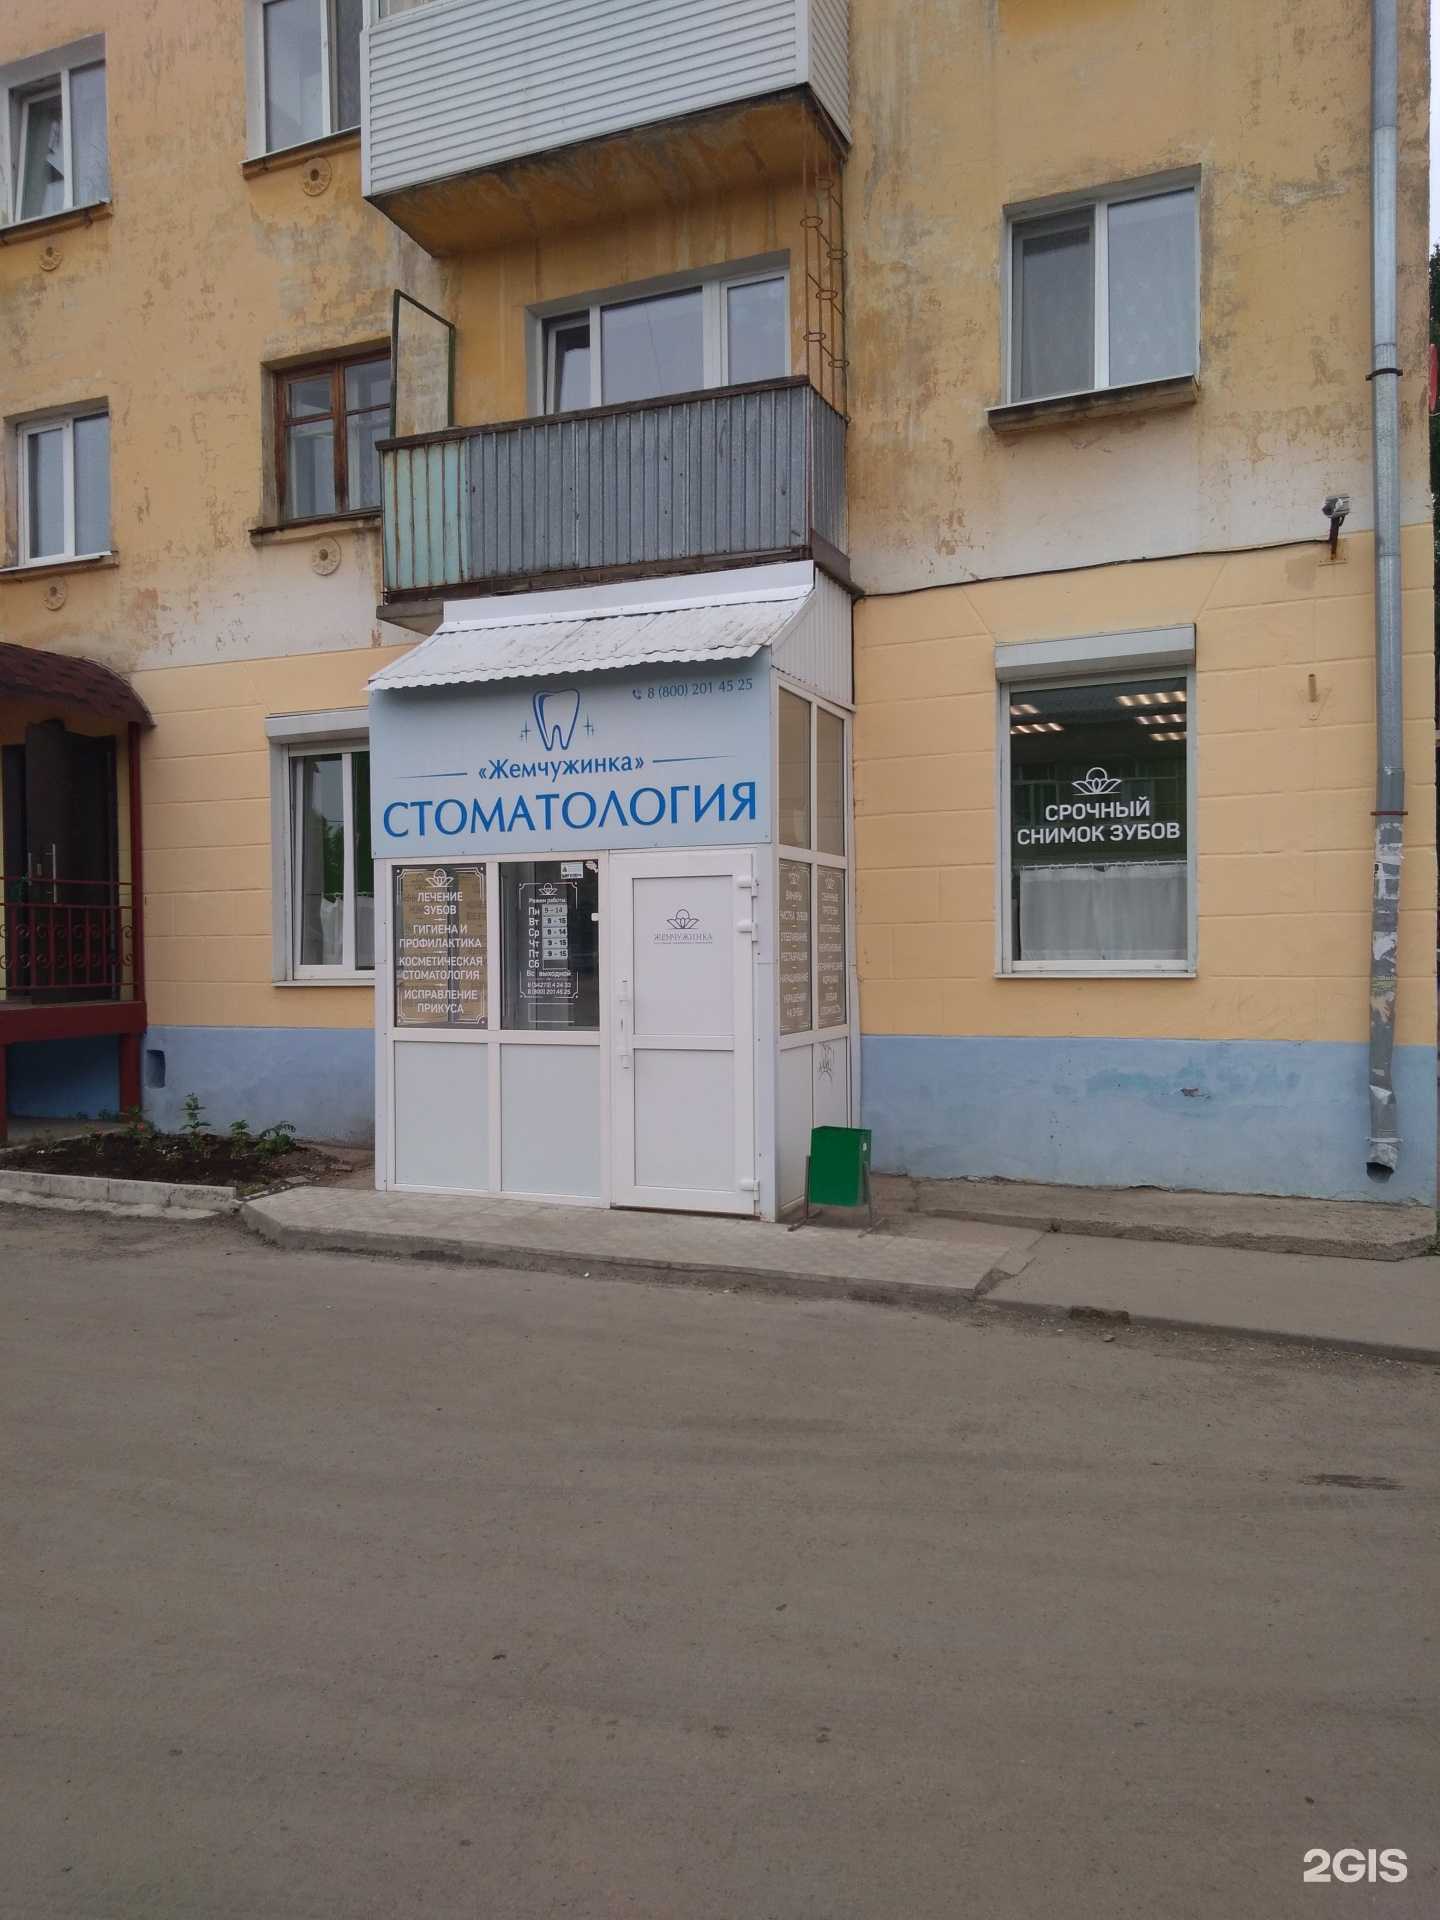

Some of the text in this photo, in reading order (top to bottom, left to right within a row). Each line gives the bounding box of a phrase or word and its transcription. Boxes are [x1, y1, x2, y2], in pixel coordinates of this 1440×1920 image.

[647, 678, 753, 700] 8 (800) 201 45 25
[478, 754, 644, 783] «Жемчужинка»
[382, 781, 757, 838] СТОМАТОЛОГИЯ
[1044, 796, 1151, 822] СРОЧНЫЙ
[1017, 822, 1181, 846] СНИМОК ЗУБОВ
[417, 891, 463, 903] ЛЕЧЕНИЕ
[423, 905, 457, 916] ЗУБОВ
[528, 917, 540, 926] Вт
[413, 923, 468, 935] ГИГИЕНА И
[528, 928, 540, 939] Ср
[399, 937, 482, 949] ПРОФИЛАКТИКА
[528, 939, 540, 949] Чт
[528, 949, 540, 959] Пт
[399, 955, 483, 967] КОСМЕТИЧЕСКАЯ
[528, 959, 540, 969] Сб
[402, 969, 480, 981] СТОМАТОЛОГИЯ
[404, 988, 479, 1000] ИСПРАВЛЕНИЕ
[417, 1002, 464, 1014] ПРИКУСА
